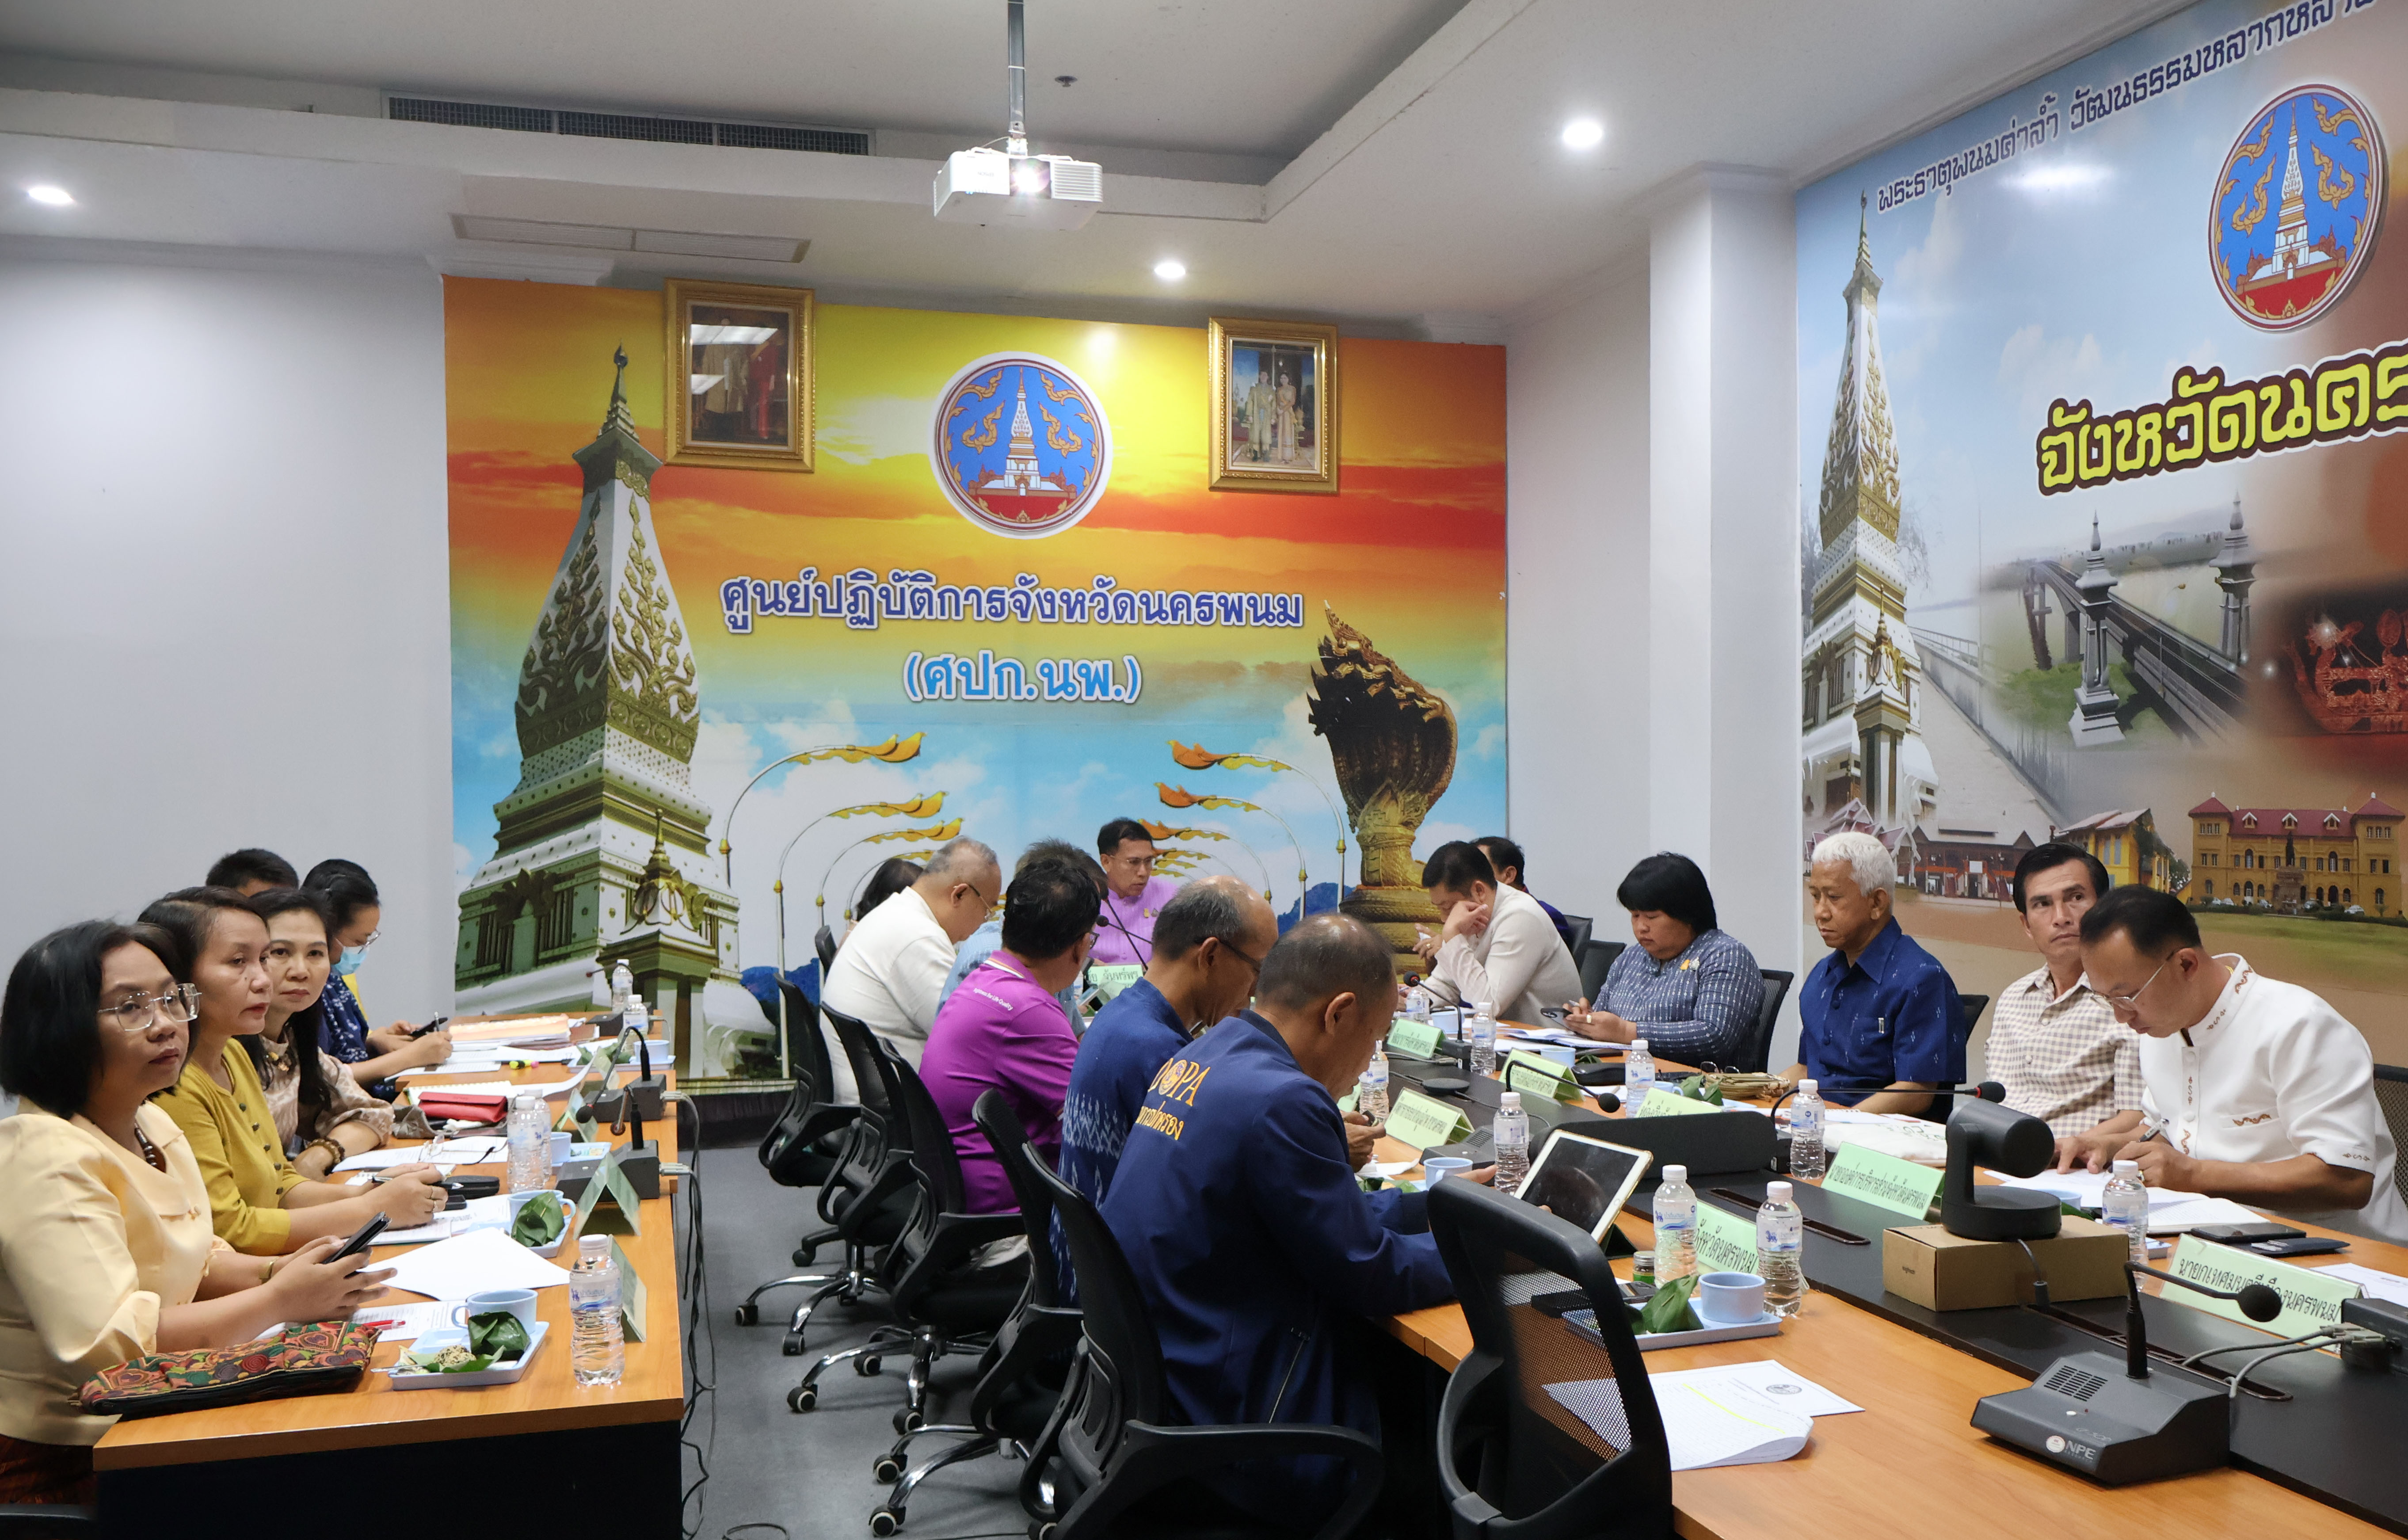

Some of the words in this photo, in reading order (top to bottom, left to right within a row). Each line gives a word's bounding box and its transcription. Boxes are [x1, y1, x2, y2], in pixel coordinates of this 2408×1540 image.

[721, 568, 1303, 632] ศูนย์ปฏิบัติการจังหวัดนครพนม
[905, 652, 1140, 701] (ศปก.นพ.)
[2066, 1440, 2096, 1460] NPE
